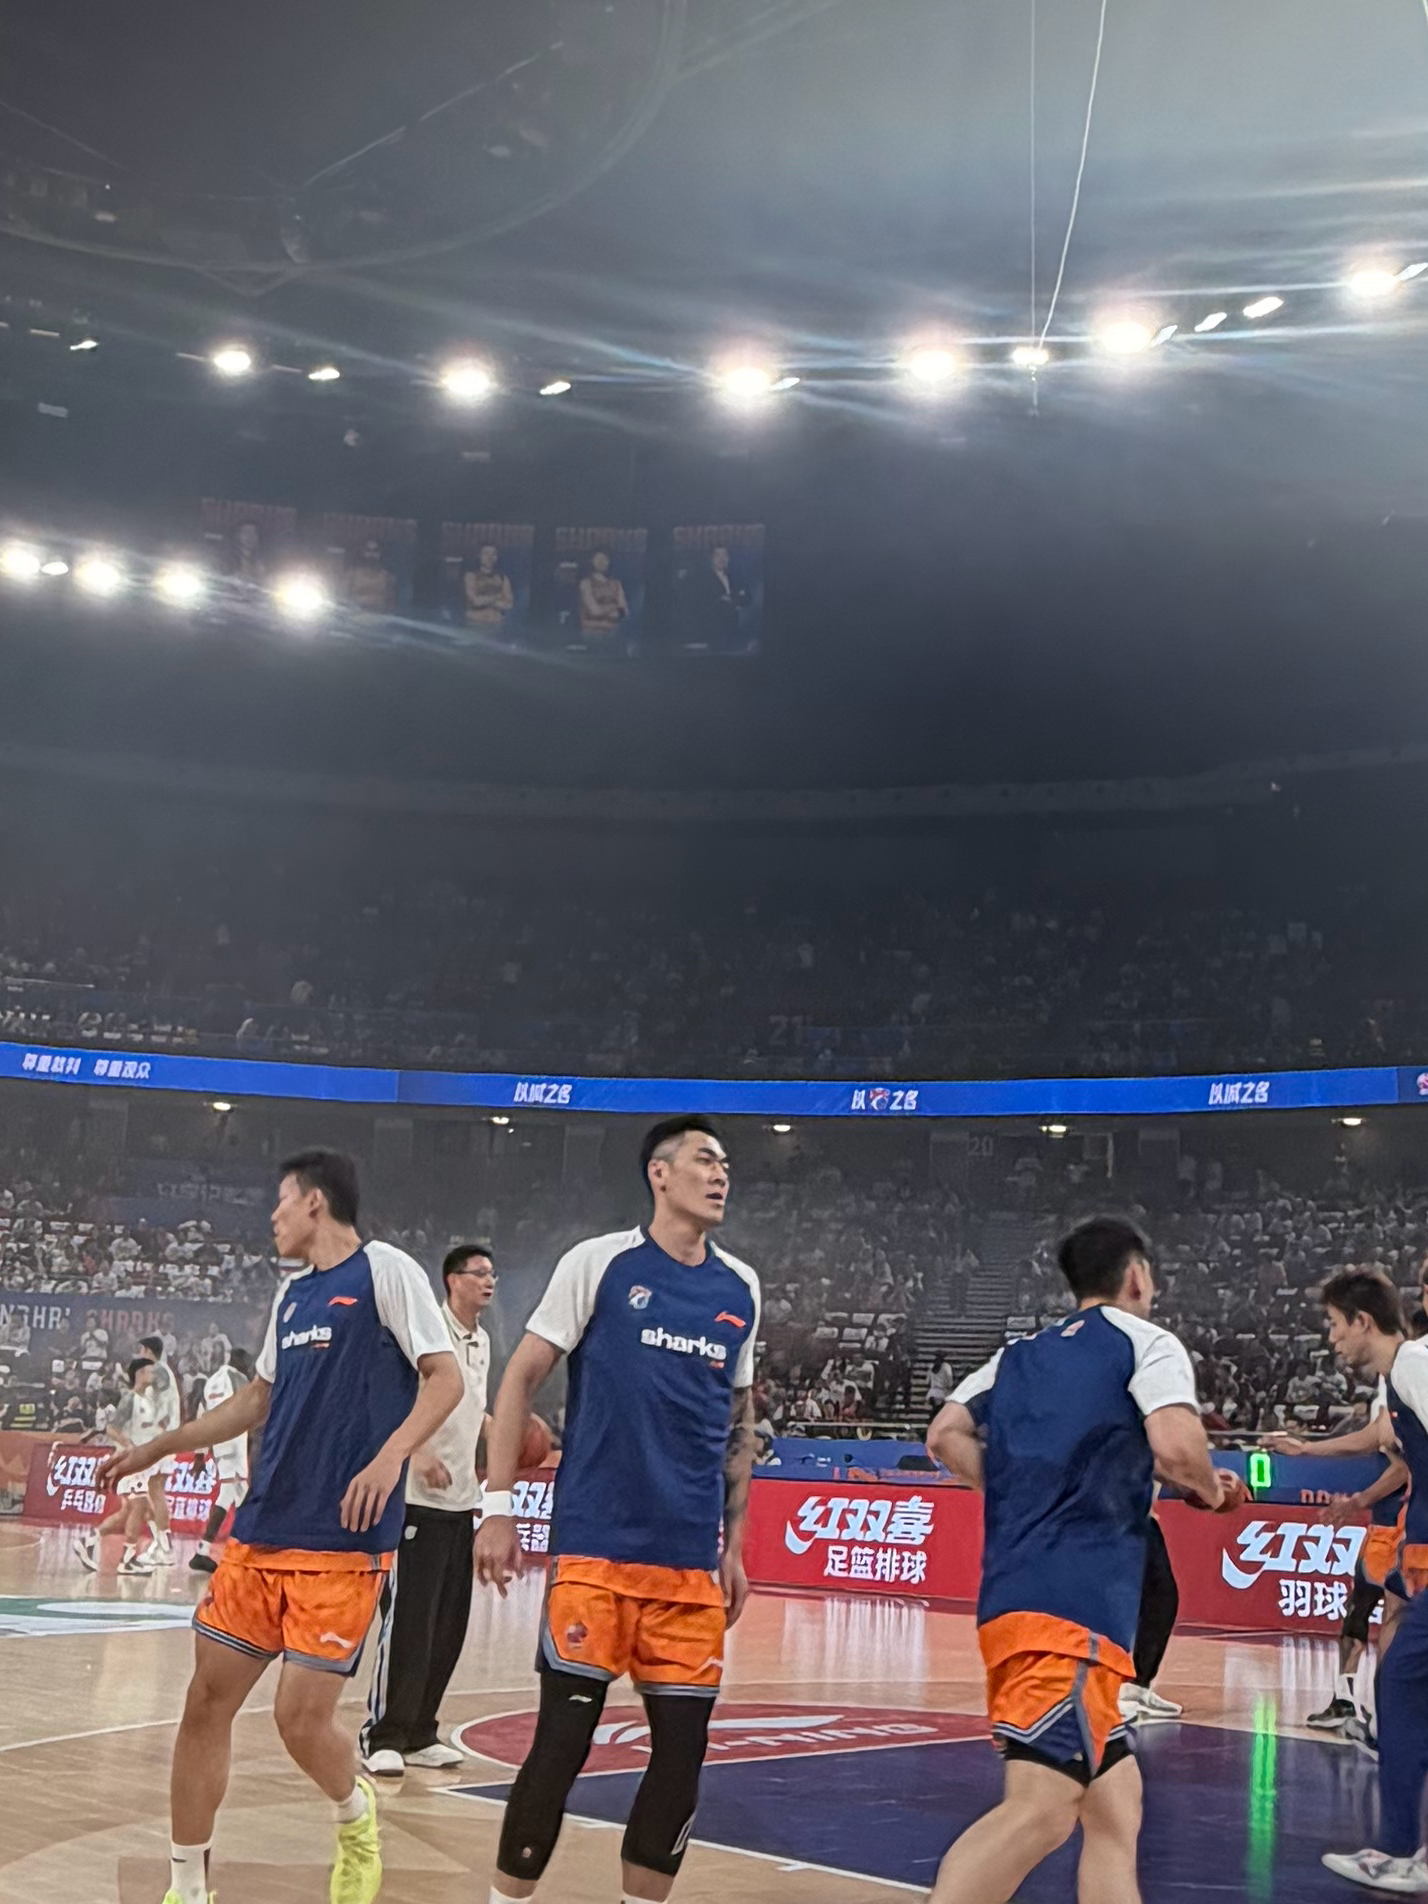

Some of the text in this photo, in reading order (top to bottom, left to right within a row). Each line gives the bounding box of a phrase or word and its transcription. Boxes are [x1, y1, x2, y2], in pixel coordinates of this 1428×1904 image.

[640, 1326, 727, 1361] sharks
[1249, 1452, 1272, 1488] 0
[785, 1496, 934, 1554] 红双喜
[824, 1545, 927, 1585] 足篮排球
[1222, 1520, 1368, 1590] 红双
